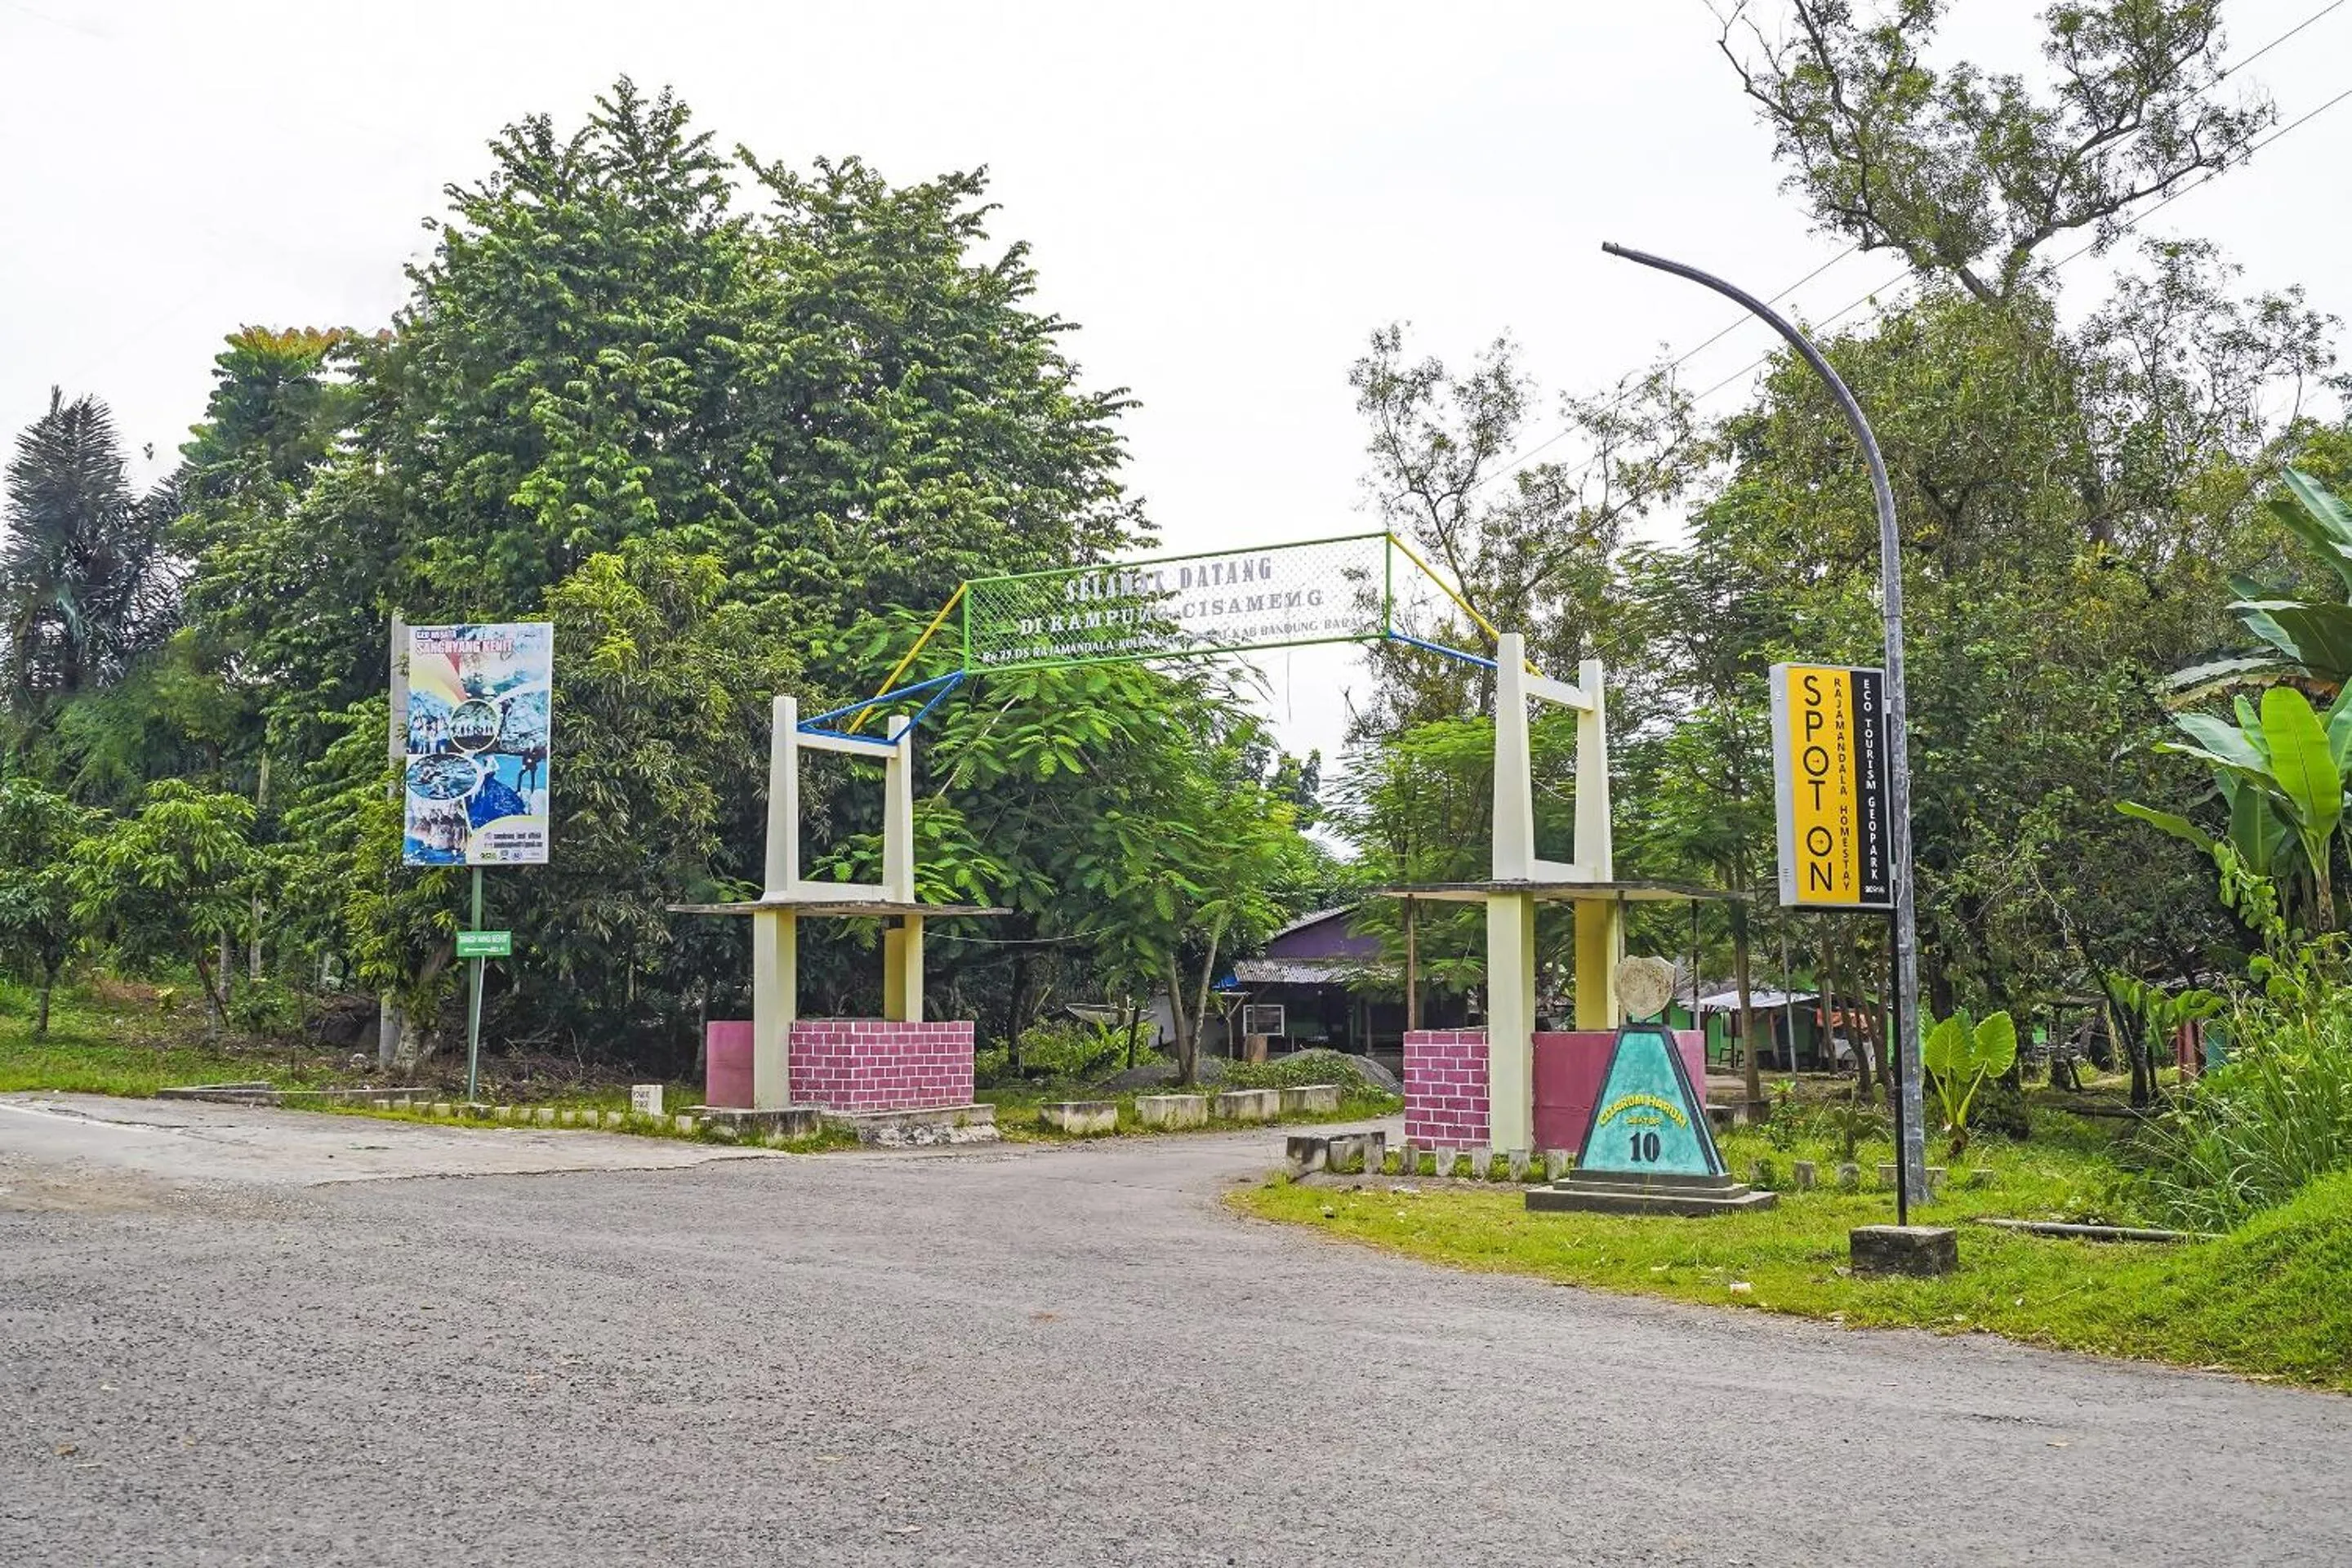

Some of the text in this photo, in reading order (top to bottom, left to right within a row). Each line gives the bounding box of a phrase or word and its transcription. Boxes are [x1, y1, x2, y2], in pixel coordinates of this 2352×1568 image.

[1066, 558, 1272, 603] SELAMAT DATANG
[1021, 618, 1042, 635] DI
[1183, 589, 1323, 618] CISAMENG
[1032, 639, 1115, 657] RAJAMANDALA
[1864, 679, 1872, 711] ECO
[1864, 719, 1876, 790] TOURISM
[1803, 675, 1833, 892] SPOT ON
[1833, 678, 1850, 891] RAJAMANDALA HOMESTAY
[1868, 797, 1878, 880] GEOPARK
[1646, 1095, 1687, 1128] HARUM
[1629, 1132, 1660, 1162] 10
